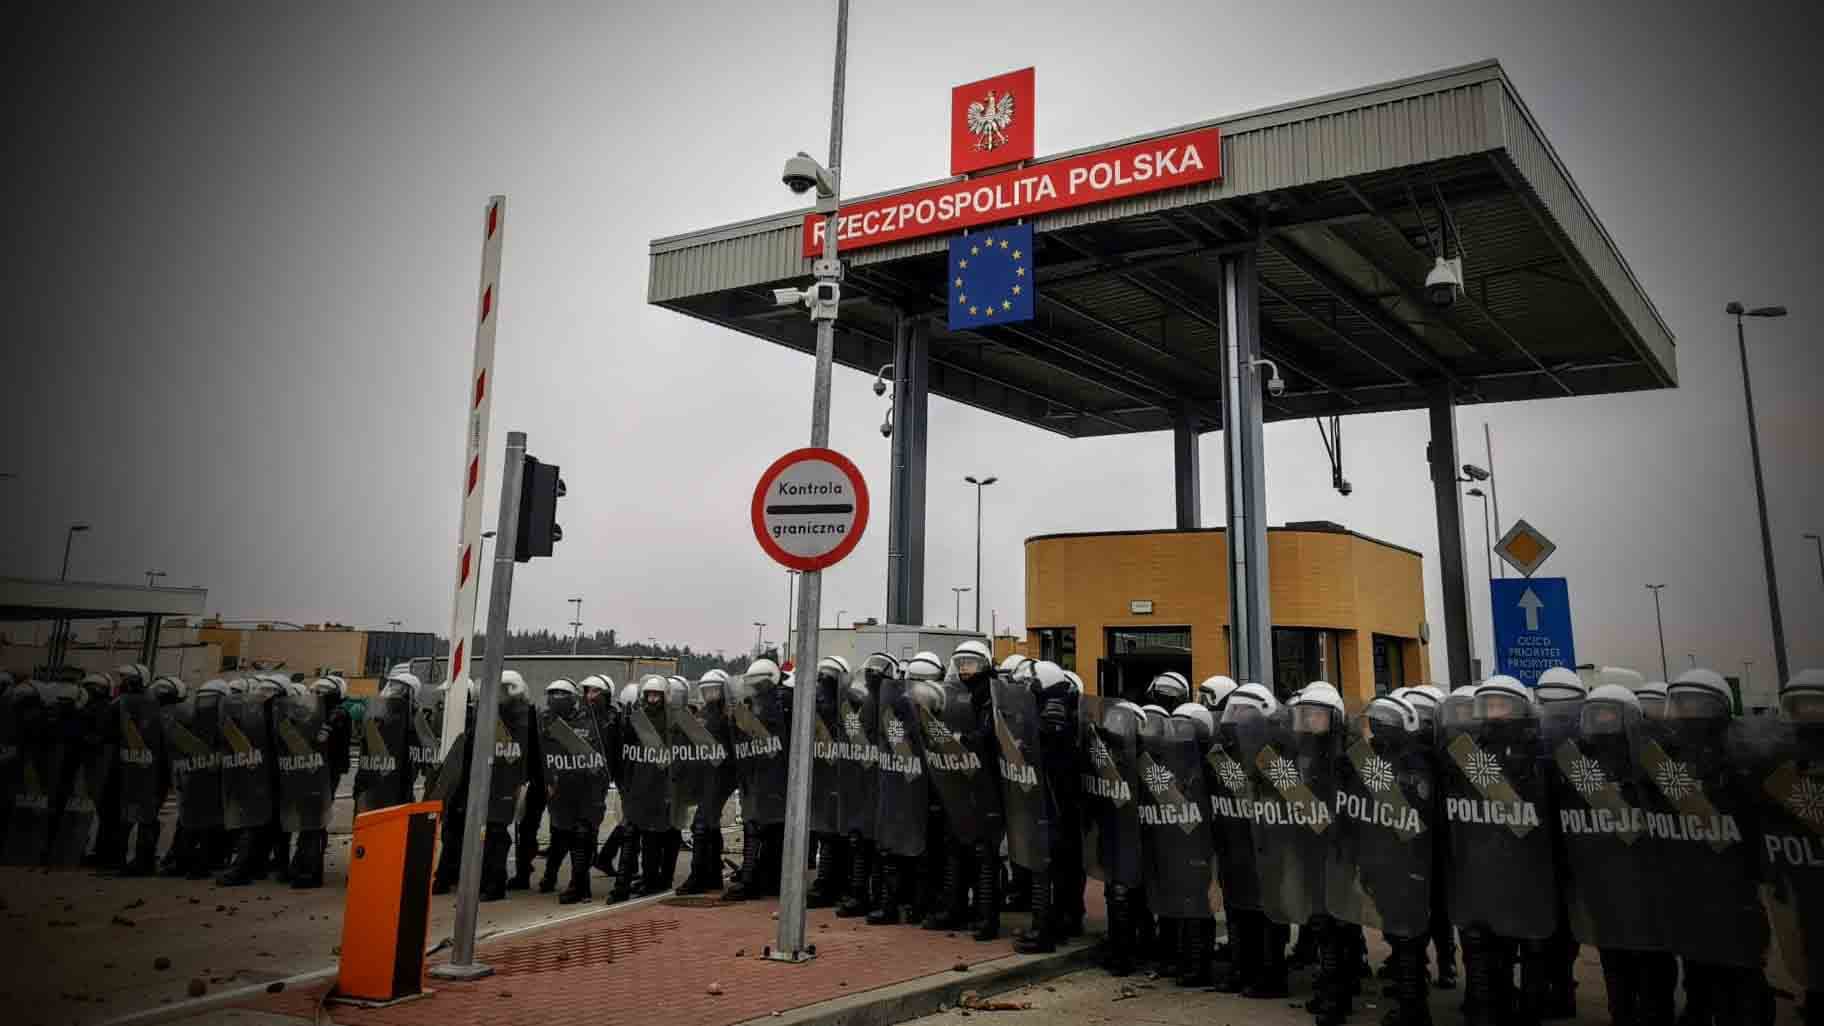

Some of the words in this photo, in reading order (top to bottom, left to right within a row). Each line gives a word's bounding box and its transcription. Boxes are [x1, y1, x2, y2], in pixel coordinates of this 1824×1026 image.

[812, 174, 1057, 246] RZECZPOSPOLITA
[1069, 144, 1203, 194] POLSKA
[778, 481, 843, 496] Kontrola
[772, 521, 846, 538] graniczna
[546, 751, 604, 769] POLICJA
[622, 743, 671, 764] POLICJA
[672, 743, 726, 761] POLICJA
[814, 741, 839, 759] ICJA
[1138, 802, 1203, 825] POLICJA
[1210, 794, 1253, 819] POLIC
[1254, 800, 1332, 825] POLICJA
[1335, 789, 1421, 834] POLICJA
[1446, 797, 1539, 826] POLICJA
[1646, 811, 1743, 840] POLICJA
